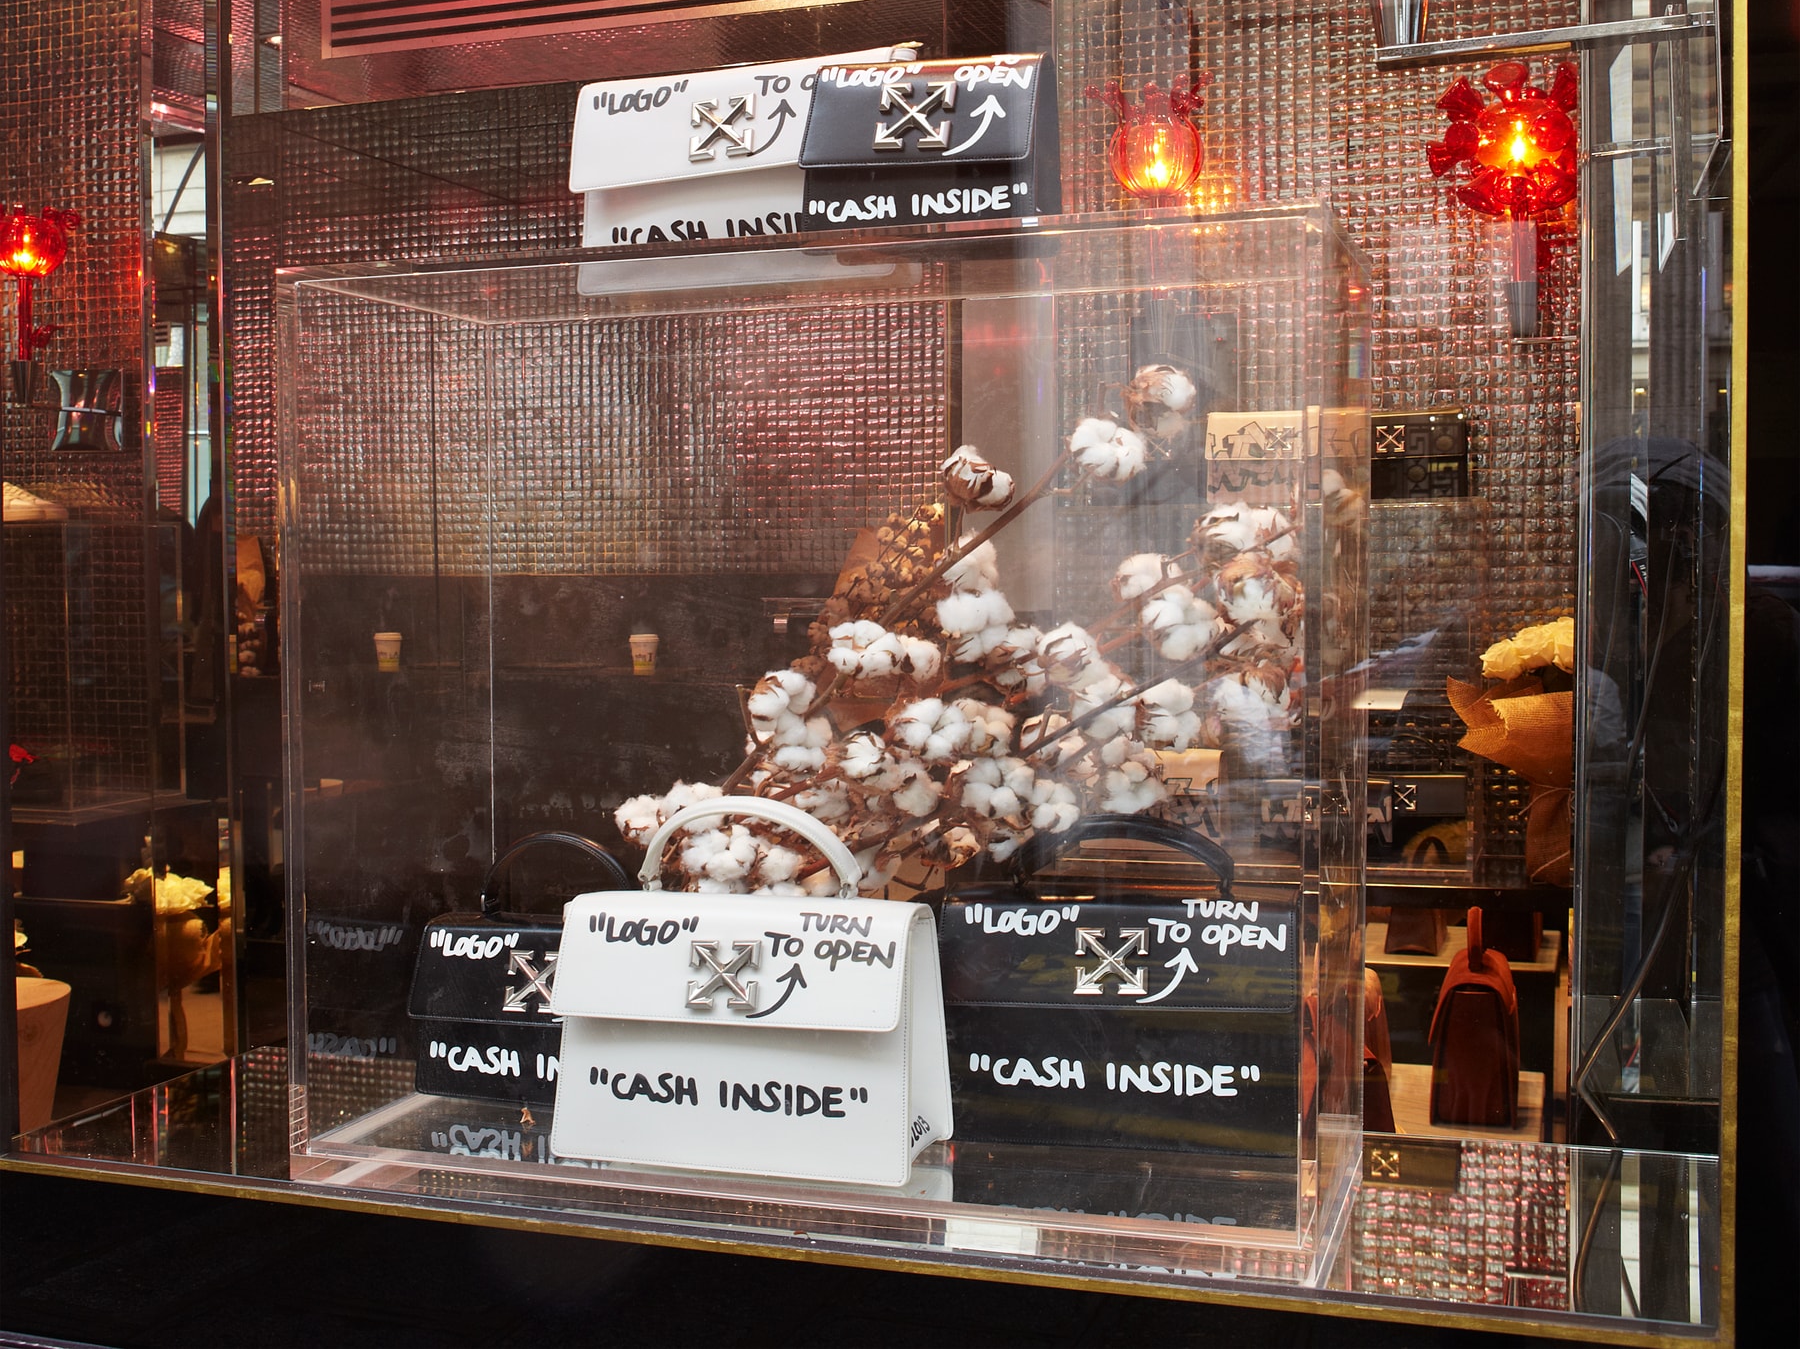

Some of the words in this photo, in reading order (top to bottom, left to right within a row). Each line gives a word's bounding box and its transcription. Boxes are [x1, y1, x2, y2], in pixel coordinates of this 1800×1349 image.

[754, 75, 792, 96] TO
[821, 63, 923, 88] "LOGO"
[953, 64, 1034, 92] OPEN
[592, 80, 689, 116] "LOGO"
[808, 195, 897, 223] "CASH
[912, 183, 1028, 217] INSIDE"
[800, 911, 874, 939] TURN
[964, 902, 1081, 936] "LOGO"
[1180, 898, 1260, 923] TURN
[430, 928, 520, 960] "LOGO"
[588, 911, 701, 947] "LOGO"
[1147, 917, 1192, 944] TO
[1201, 922, 1287, 956] OPEN
[764, 931, 805, 959] TO
[813, 939, 897, 972] OPEN
[429, 1040, 521, 1078] "CASH
[968, 1052, 1086, 1090] "CASH
[1105, 1061, 1261, 1097] INSIDE"
[589, 1066, 699, 1107] "CASH
[718, 1079, 869, 1118] INSIDE"
